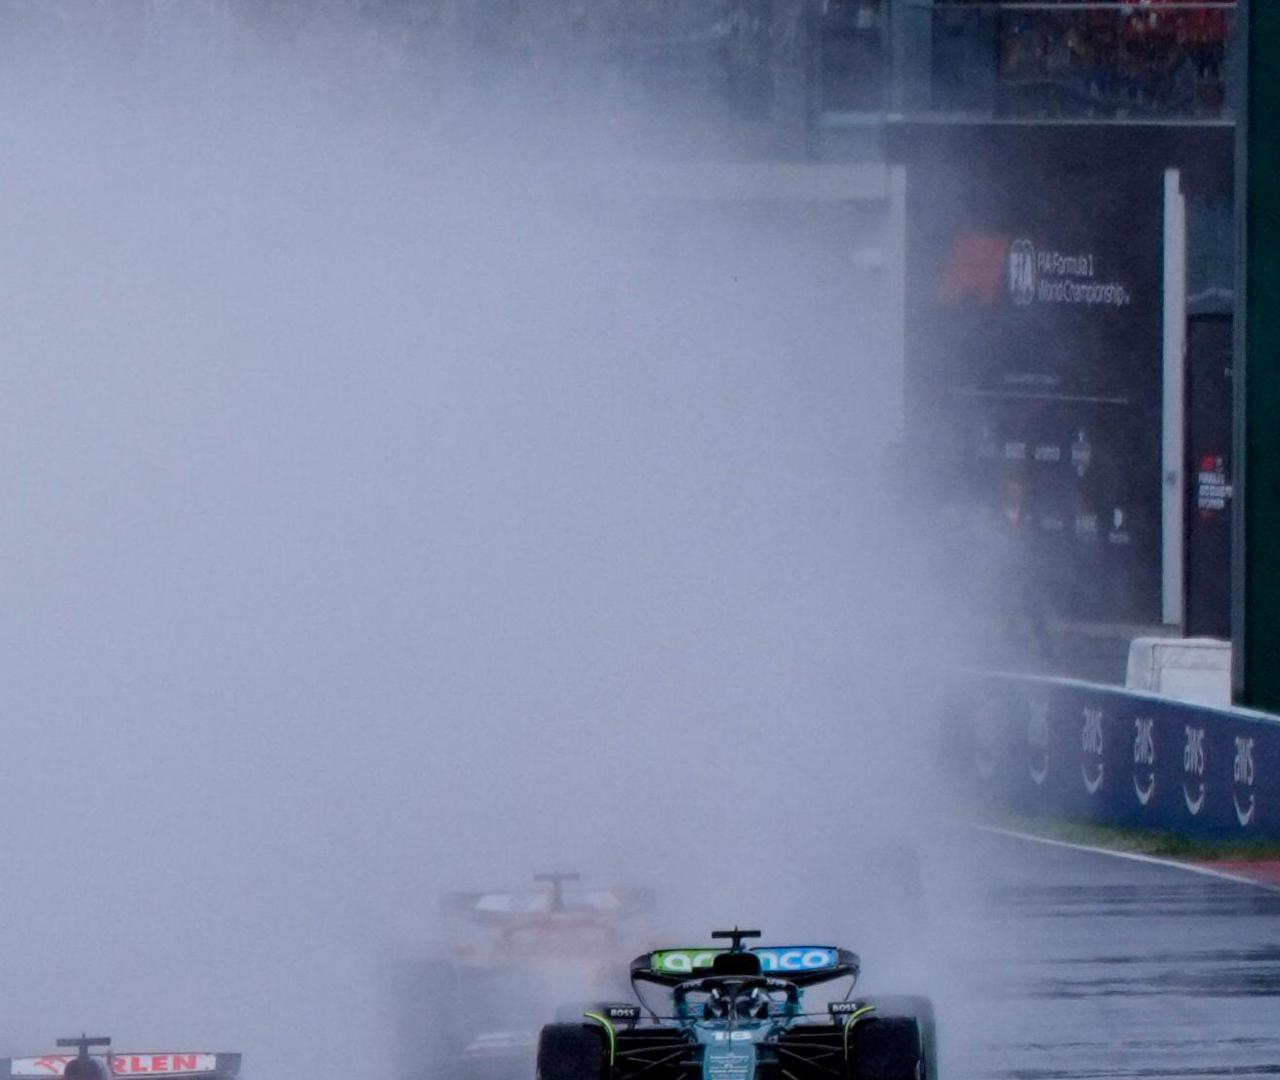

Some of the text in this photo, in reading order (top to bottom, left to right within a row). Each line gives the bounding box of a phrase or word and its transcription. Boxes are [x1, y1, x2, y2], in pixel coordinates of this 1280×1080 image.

[1054, 252, 1087, 275] Formula
[610, 1008, 636, 1018] BOSS
[112, 1054, 198, 1074] RLEN
